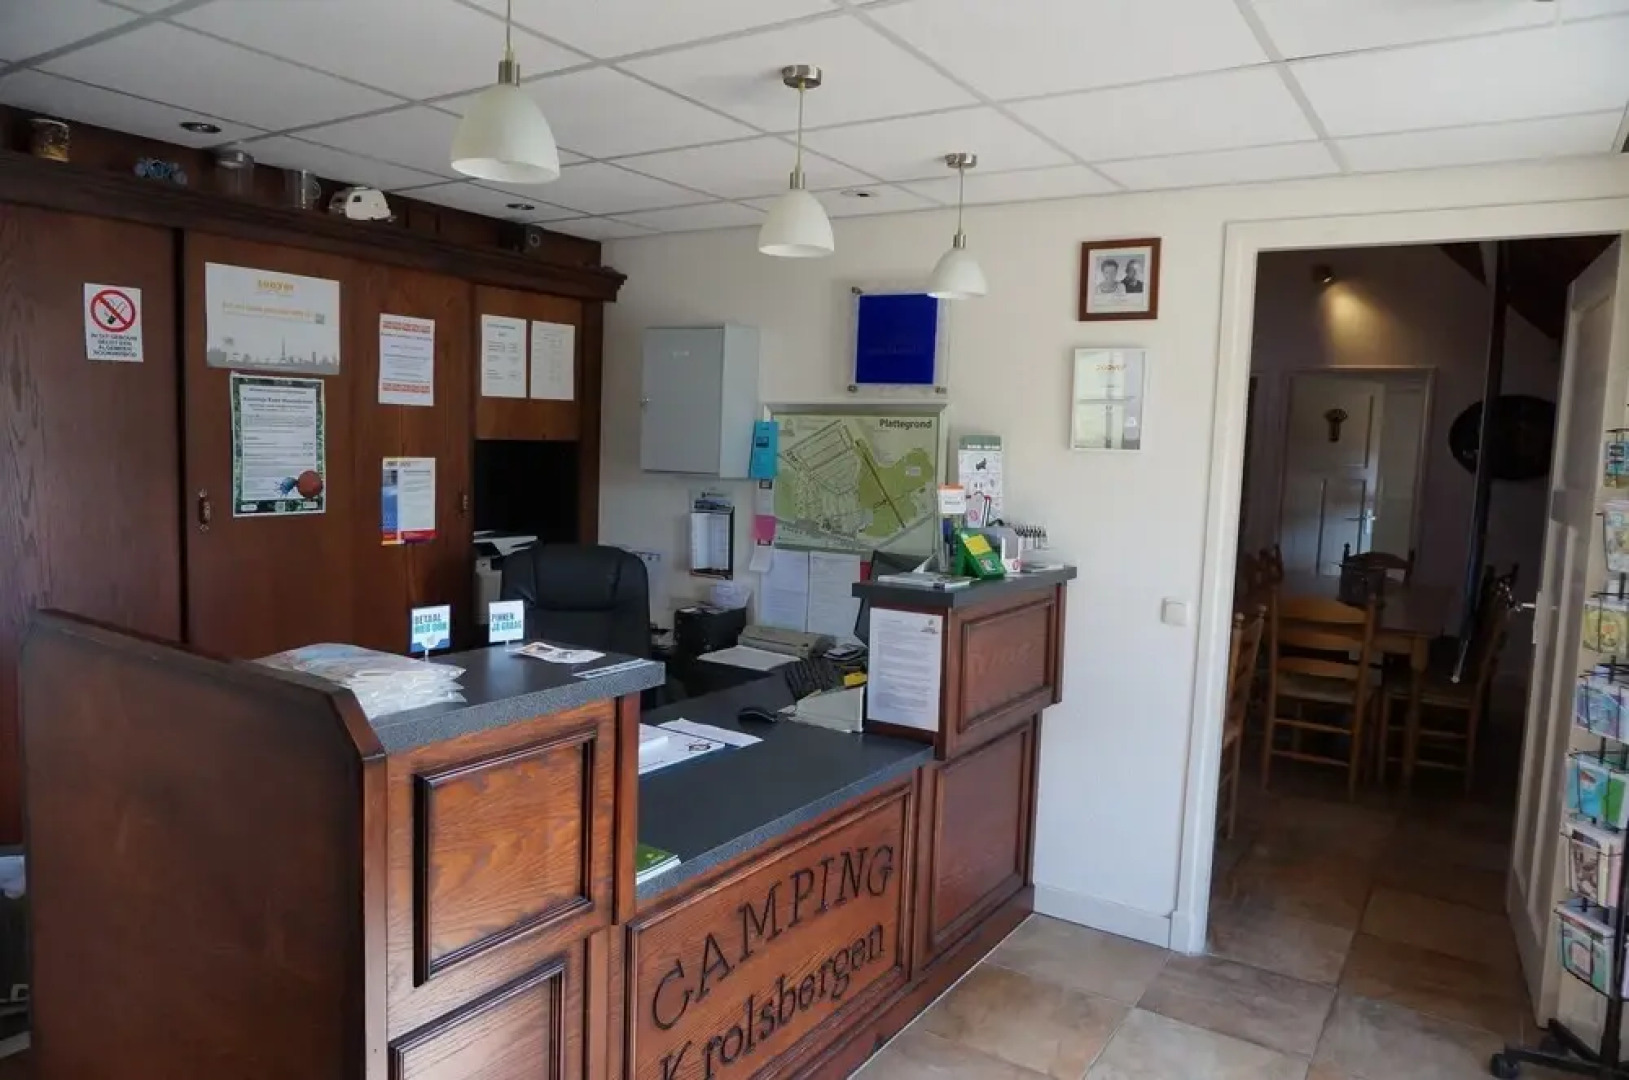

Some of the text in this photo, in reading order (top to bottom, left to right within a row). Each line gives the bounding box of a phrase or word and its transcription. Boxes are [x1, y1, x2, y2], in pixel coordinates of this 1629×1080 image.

[879, 418, 932, 429] Plattegrond
[414, 612, 442, 625] BETAAL
[651, 844, 895, 1031] CAMPING
